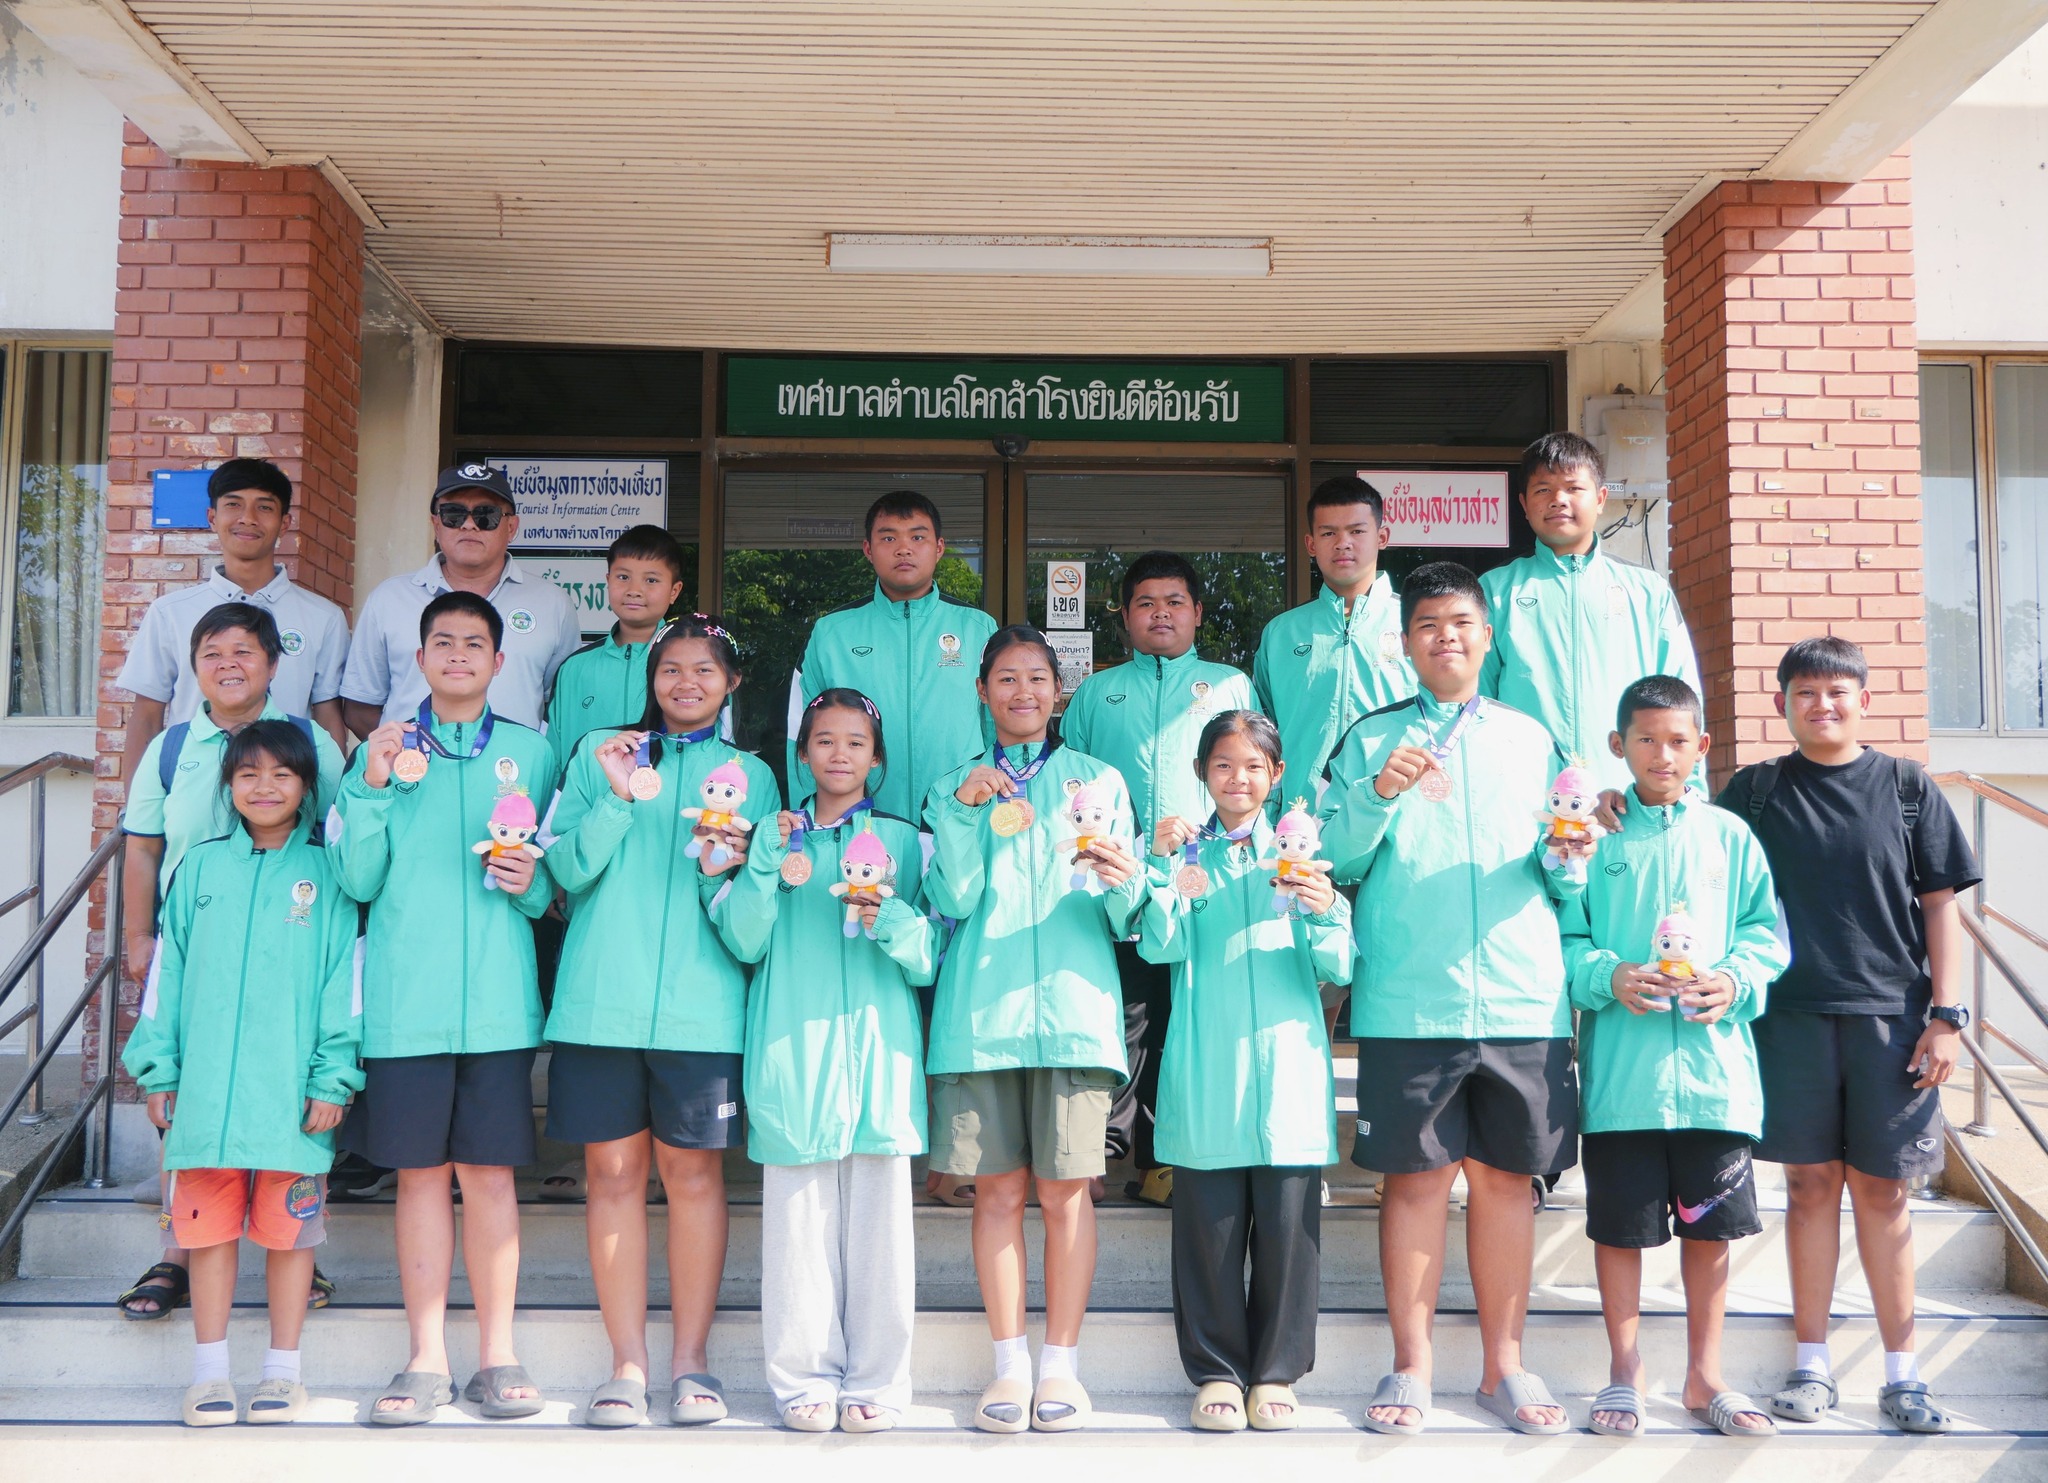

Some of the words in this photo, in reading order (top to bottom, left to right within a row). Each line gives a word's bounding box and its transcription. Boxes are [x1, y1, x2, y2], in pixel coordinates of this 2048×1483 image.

[778, 374, 1239, 422] เทศบาลตำบลโคกสำโรงยินดีต้อนรับ
[500, 464, 662, 500] นย์ข้อมูลการท่องเที่ยว
[516, 502, 549, 516] Tourist
[552, 502, 608, 519] Information
[610, 504, 641, 517] Centre
[1053, 597, 1079, 612] เขต
[1056, 645, 1090, 656] บปัญหา?
